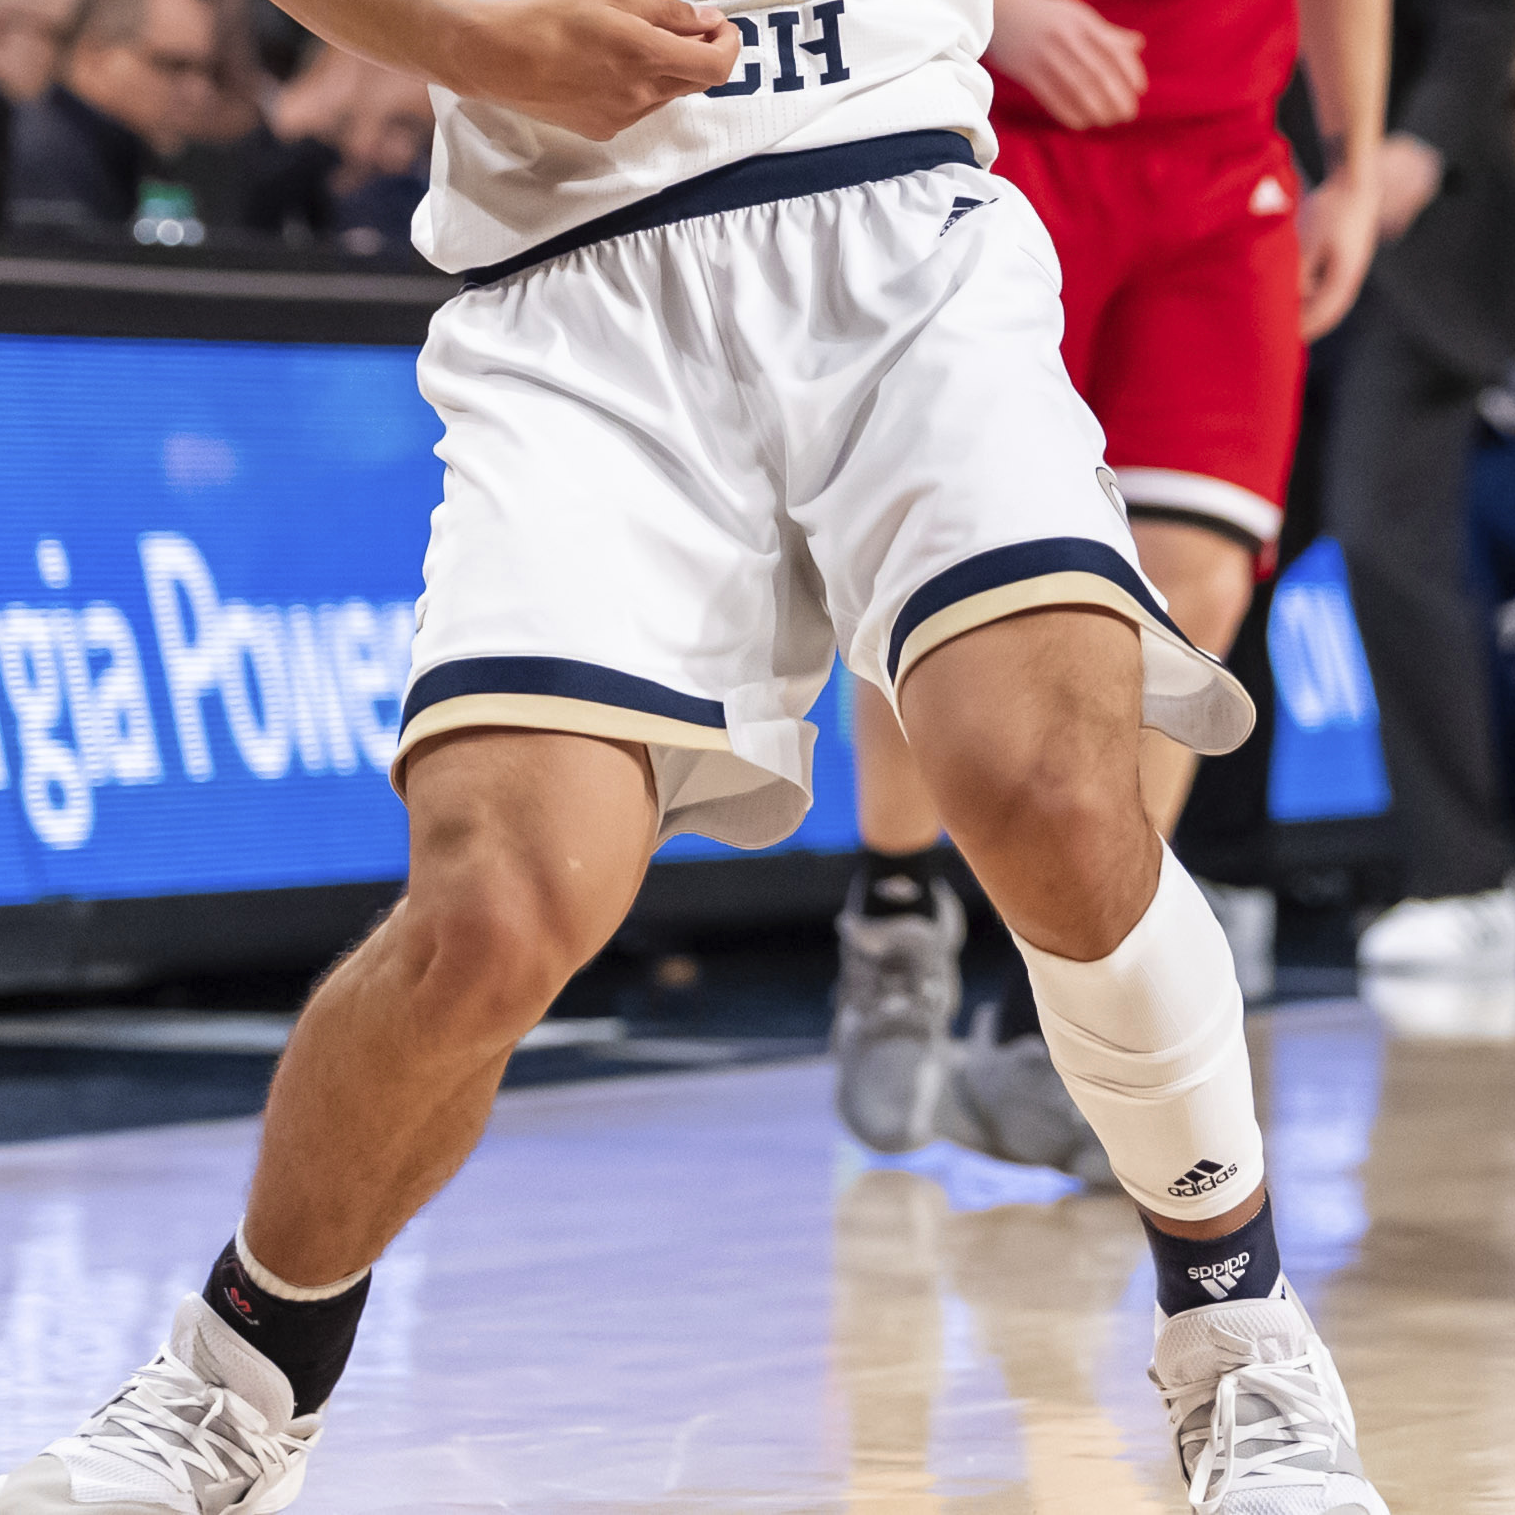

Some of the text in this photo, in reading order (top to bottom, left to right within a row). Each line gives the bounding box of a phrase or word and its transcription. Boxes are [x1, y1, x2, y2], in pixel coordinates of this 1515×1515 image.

[703, 0, 851, 98] CH
[1167, 1163, 1238, 1198] adidas
[1187, 1251, 1250, 1280] adidas
